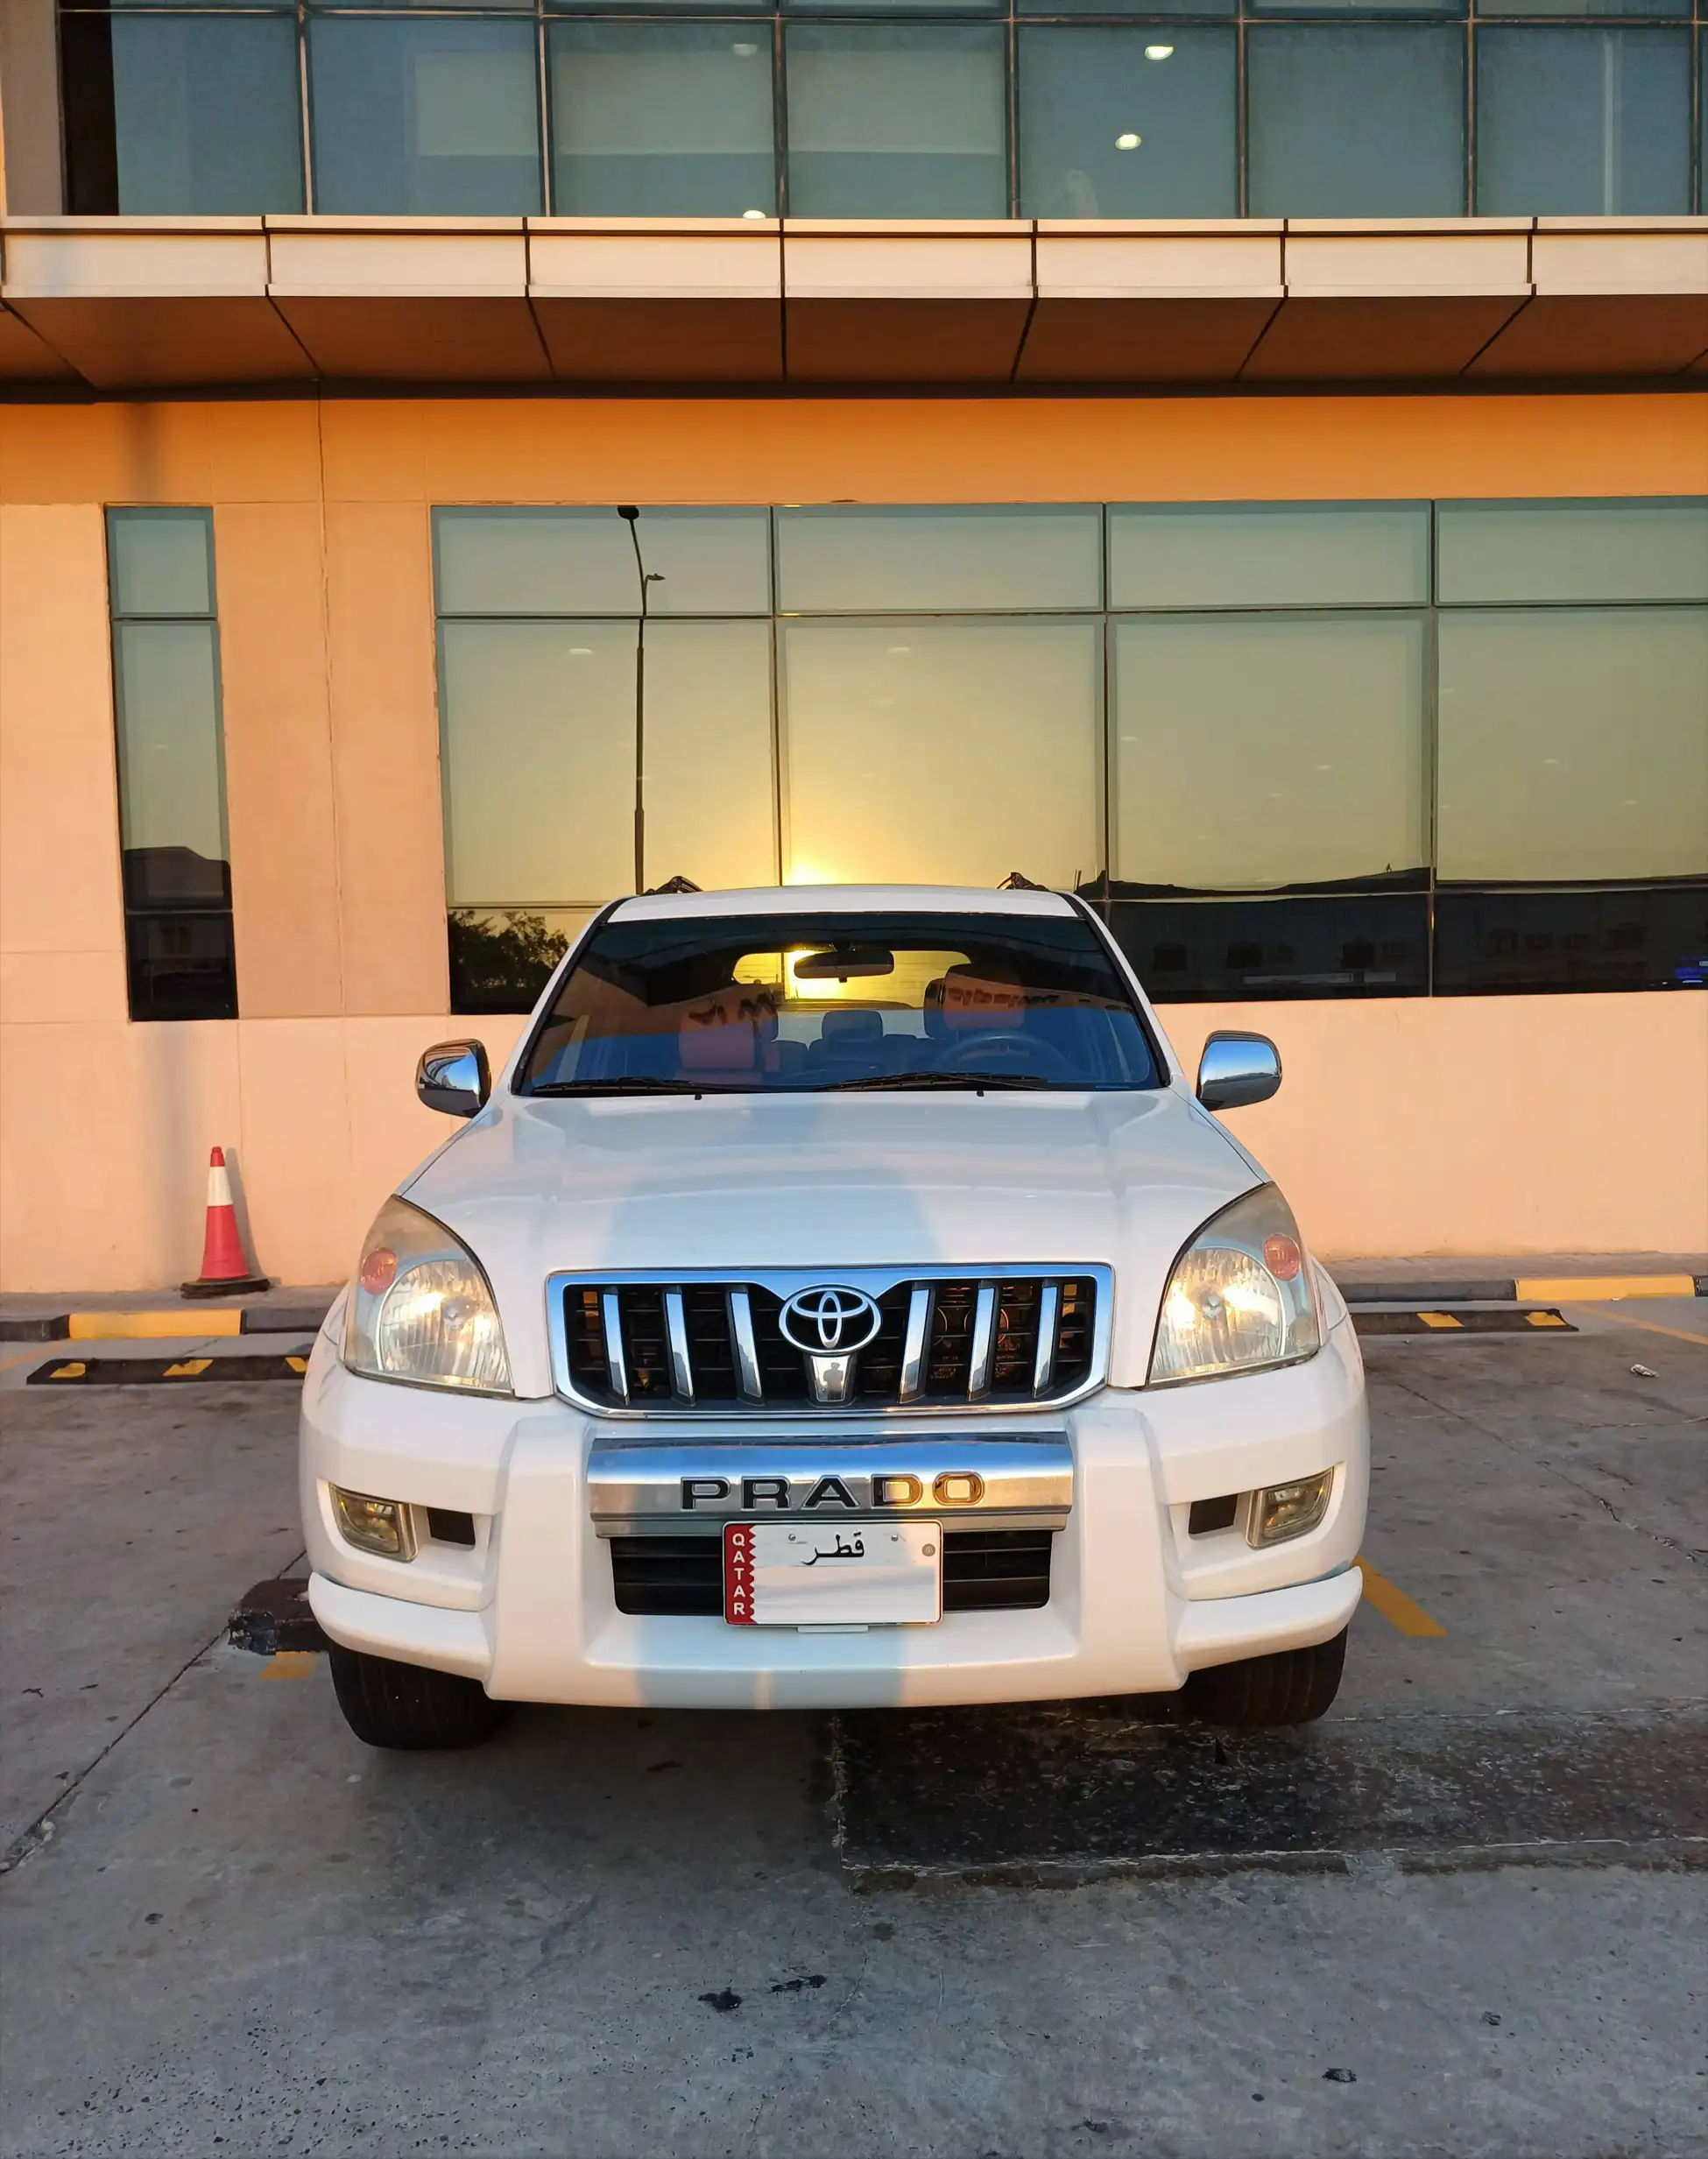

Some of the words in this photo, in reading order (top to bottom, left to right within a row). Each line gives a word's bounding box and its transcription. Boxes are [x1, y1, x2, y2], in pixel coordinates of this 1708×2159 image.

[681, 1471, 985, 1511] PRADO
[801, 1530, 865, 1566] قطر
[732, 1533, 746, 1616] QATAR
